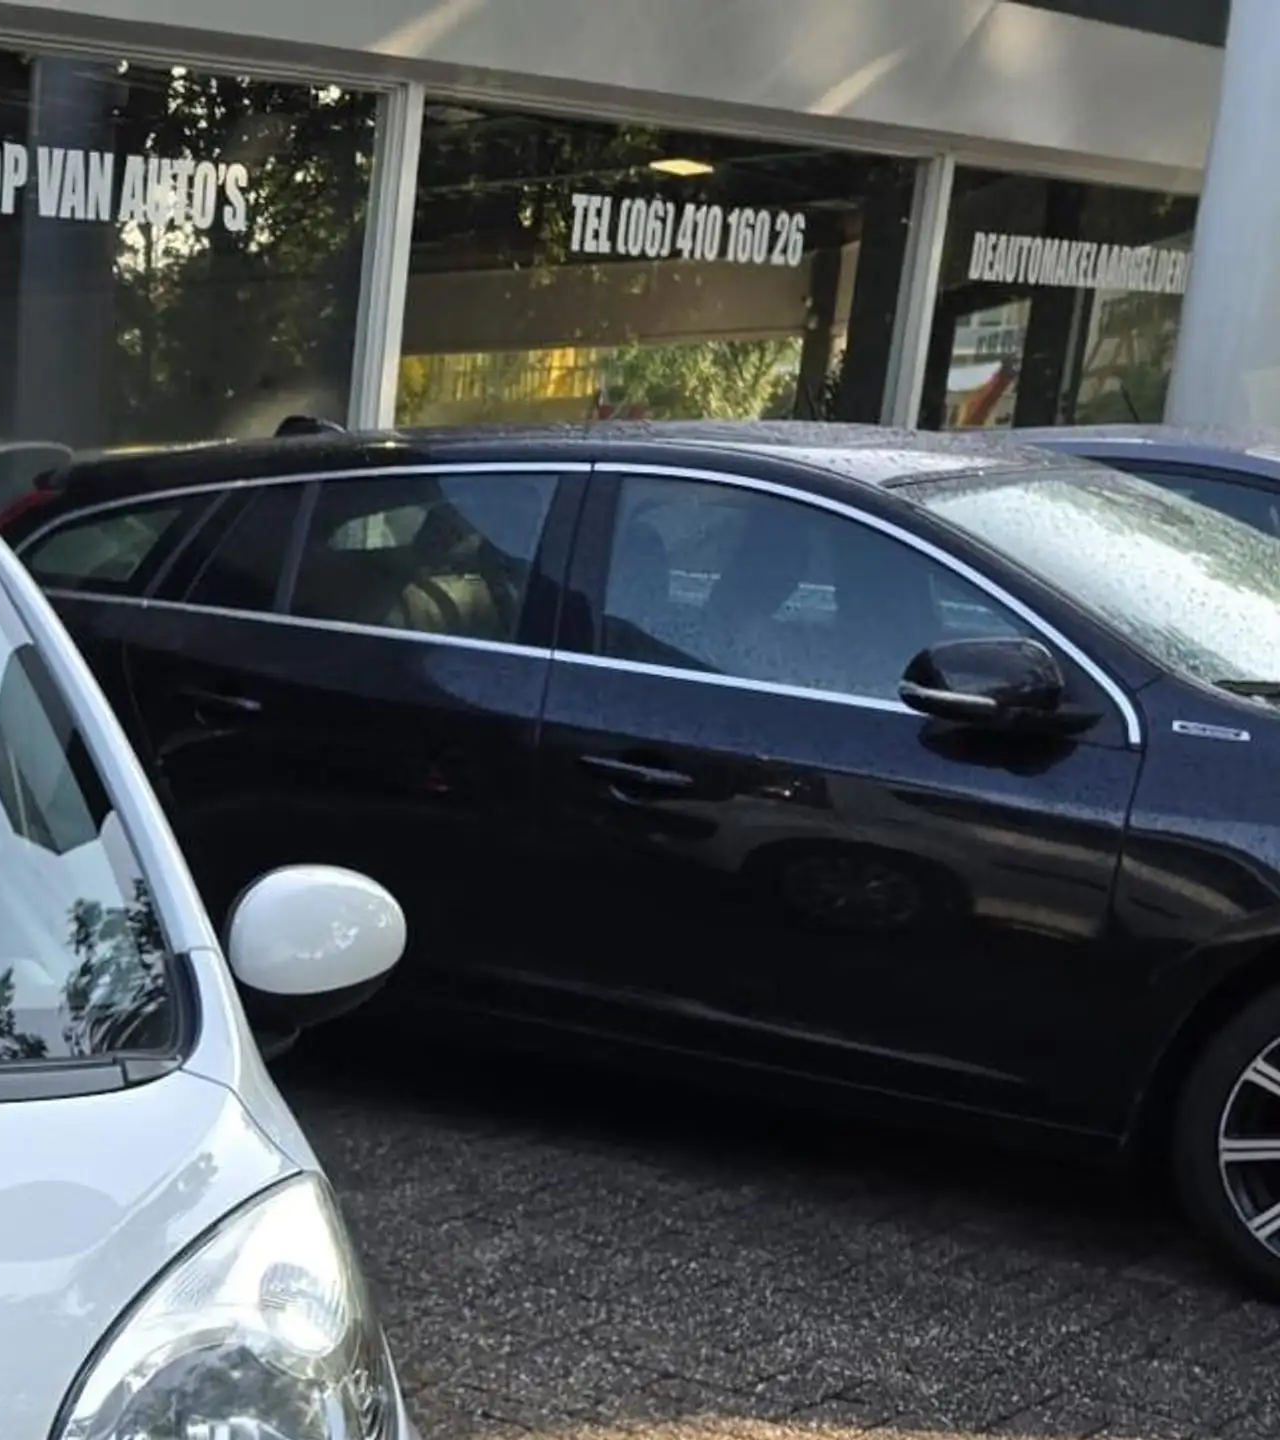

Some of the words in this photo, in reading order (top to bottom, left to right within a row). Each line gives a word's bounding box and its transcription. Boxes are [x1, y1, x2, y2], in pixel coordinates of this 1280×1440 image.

[37, 146, 114, 221] VAN
[118, 154, 248, 232] AUTO'S
[571, 193, 614, 253] TEL
[616, 198, 676, 258] (06)
[676, 203, 723, 262] 410
[727, 207, 771, 265] 160
[770, 209, 806, 267] 26
